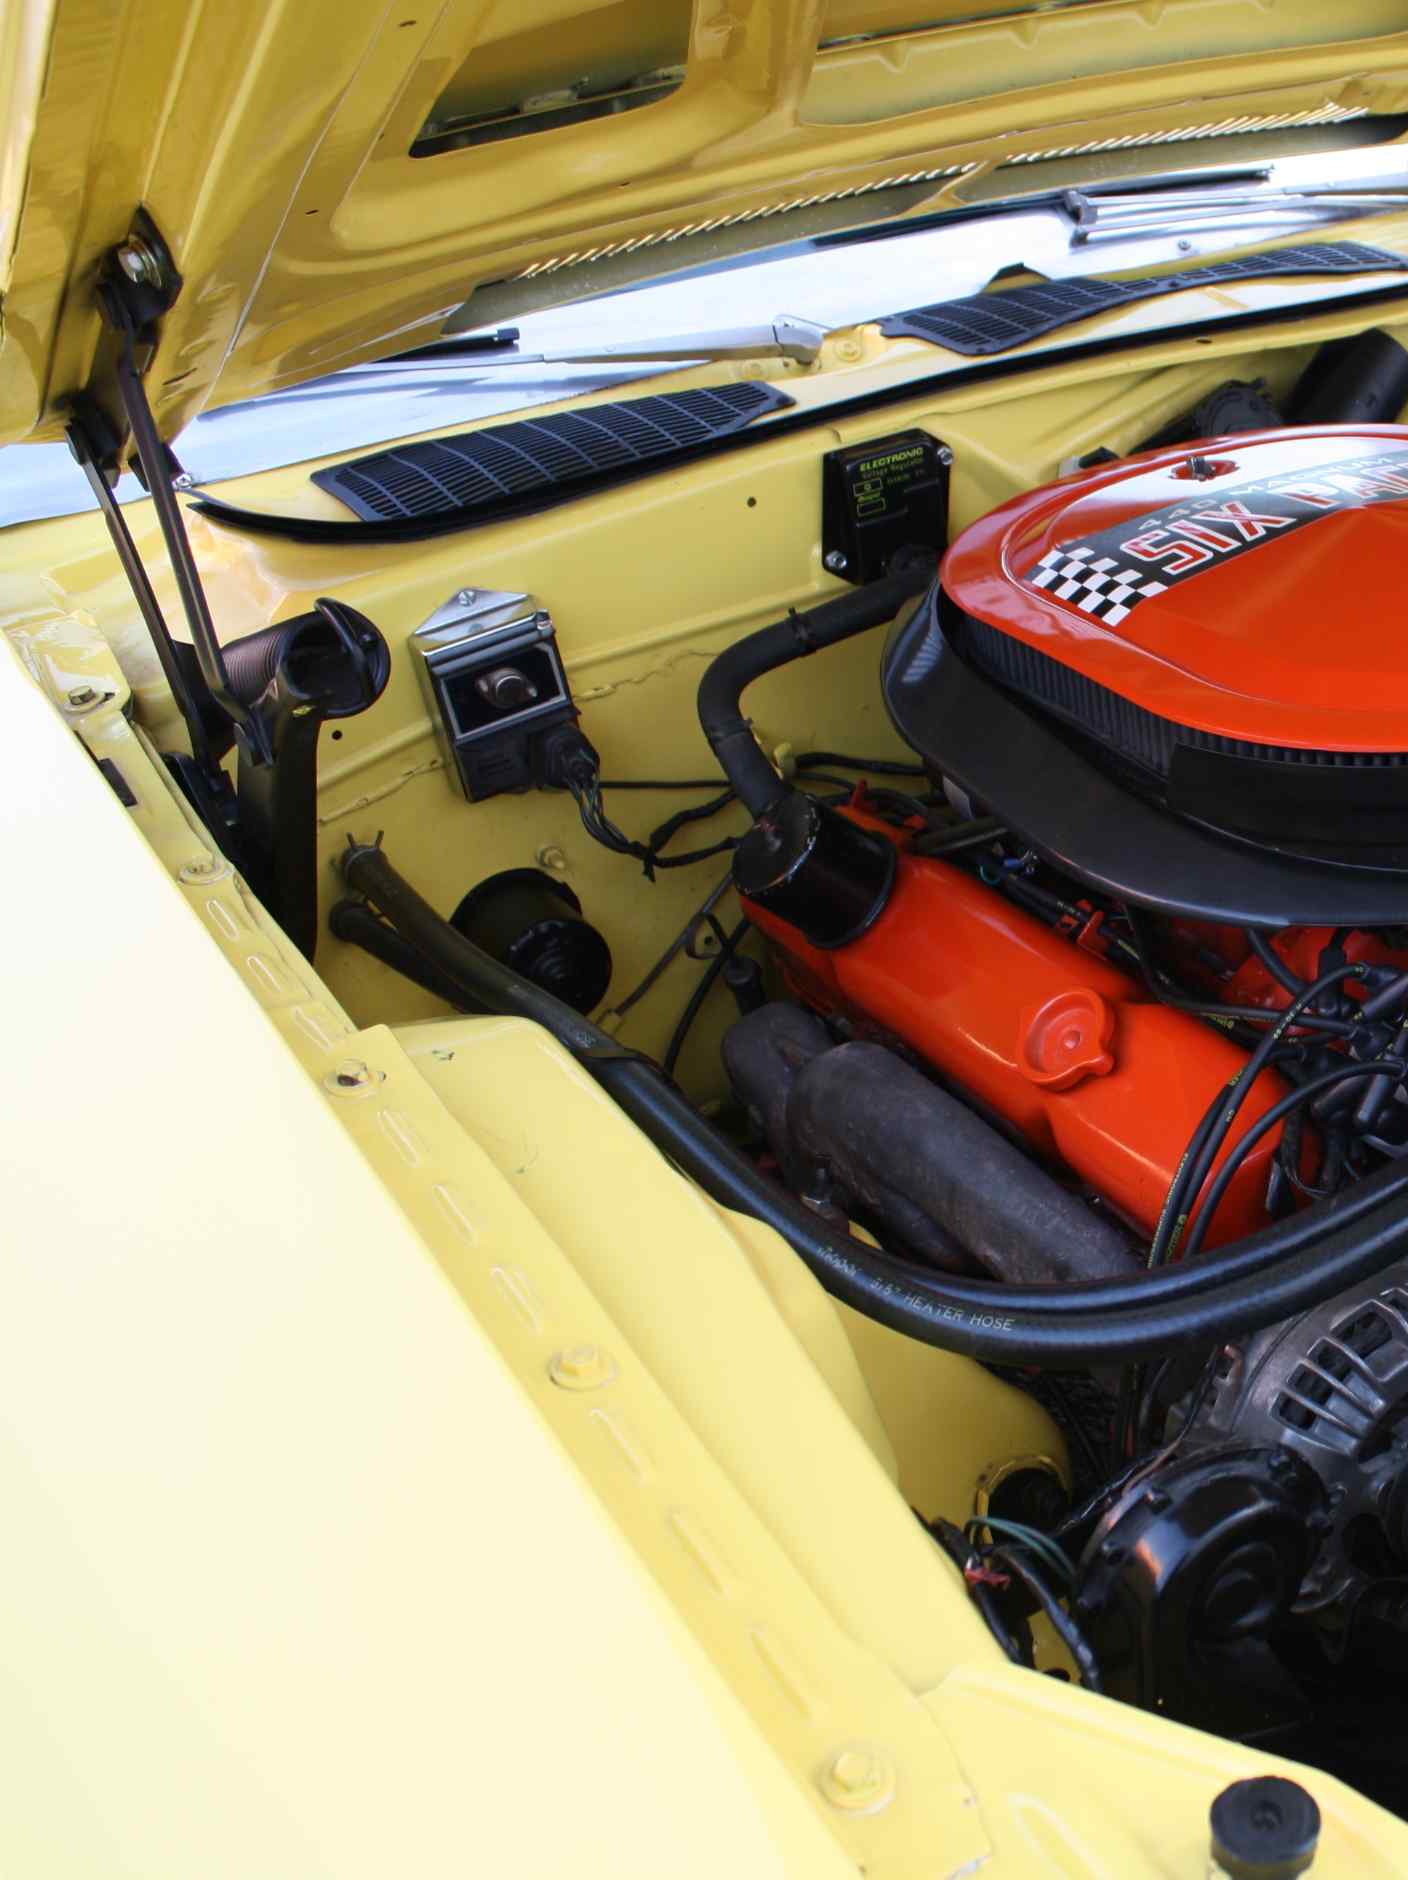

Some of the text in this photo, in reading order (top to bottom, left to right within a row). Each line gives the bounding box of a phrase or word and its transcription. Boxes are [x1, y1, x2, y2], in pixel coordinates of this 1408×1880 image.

[860, 447, 924, 471] ELECTRONIC
[1138, 499, 1218, 531] 440
[1119, 500, 1297, 576] SIX
[904, 1295, 964, 1322] HEATER
[969, 1314, 1016, 1332] HOSE
